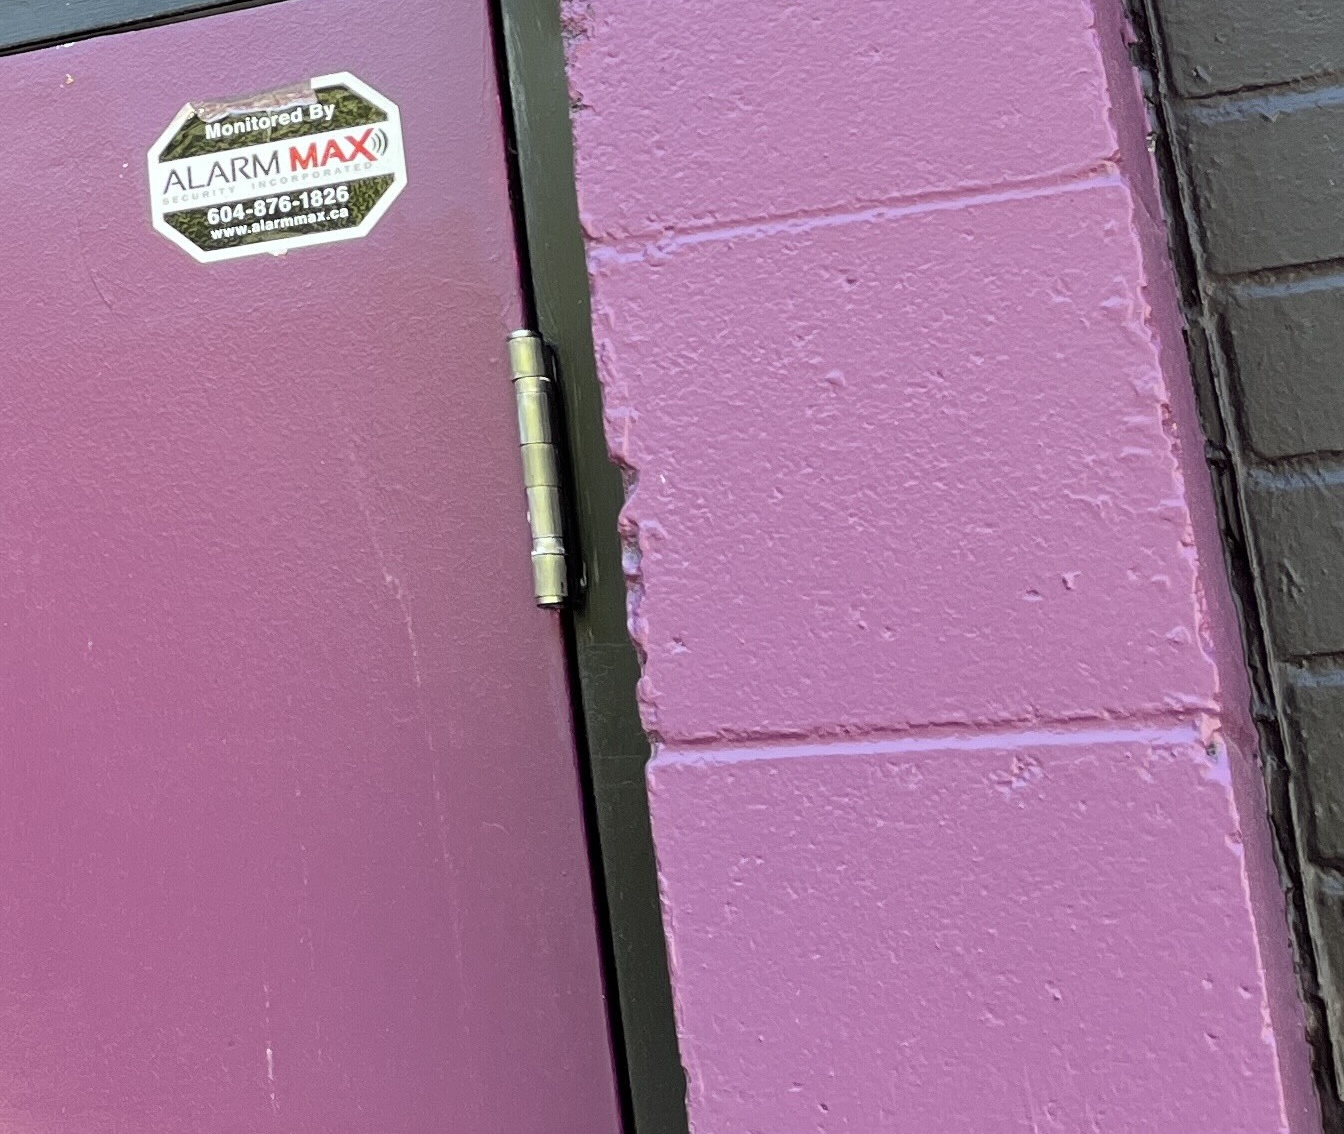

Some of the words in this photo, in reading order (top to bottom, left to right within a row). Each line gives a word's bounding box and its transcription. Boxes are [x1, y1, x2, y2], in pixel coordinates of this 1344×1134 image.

[205, 107, 303, 139] Monitored
[309, 103, 336, 121] By
[163, 150, 280, 195] ALARM
[288, 127, 379, 172] MAX
[162, 186, 236, 205] SECURITY
[251, 162, 373, 189] INCORPORATED
[207, 185, 350, 225] 604-876-1826
[210, 207, 350, 239] www.alarmmax.ca
